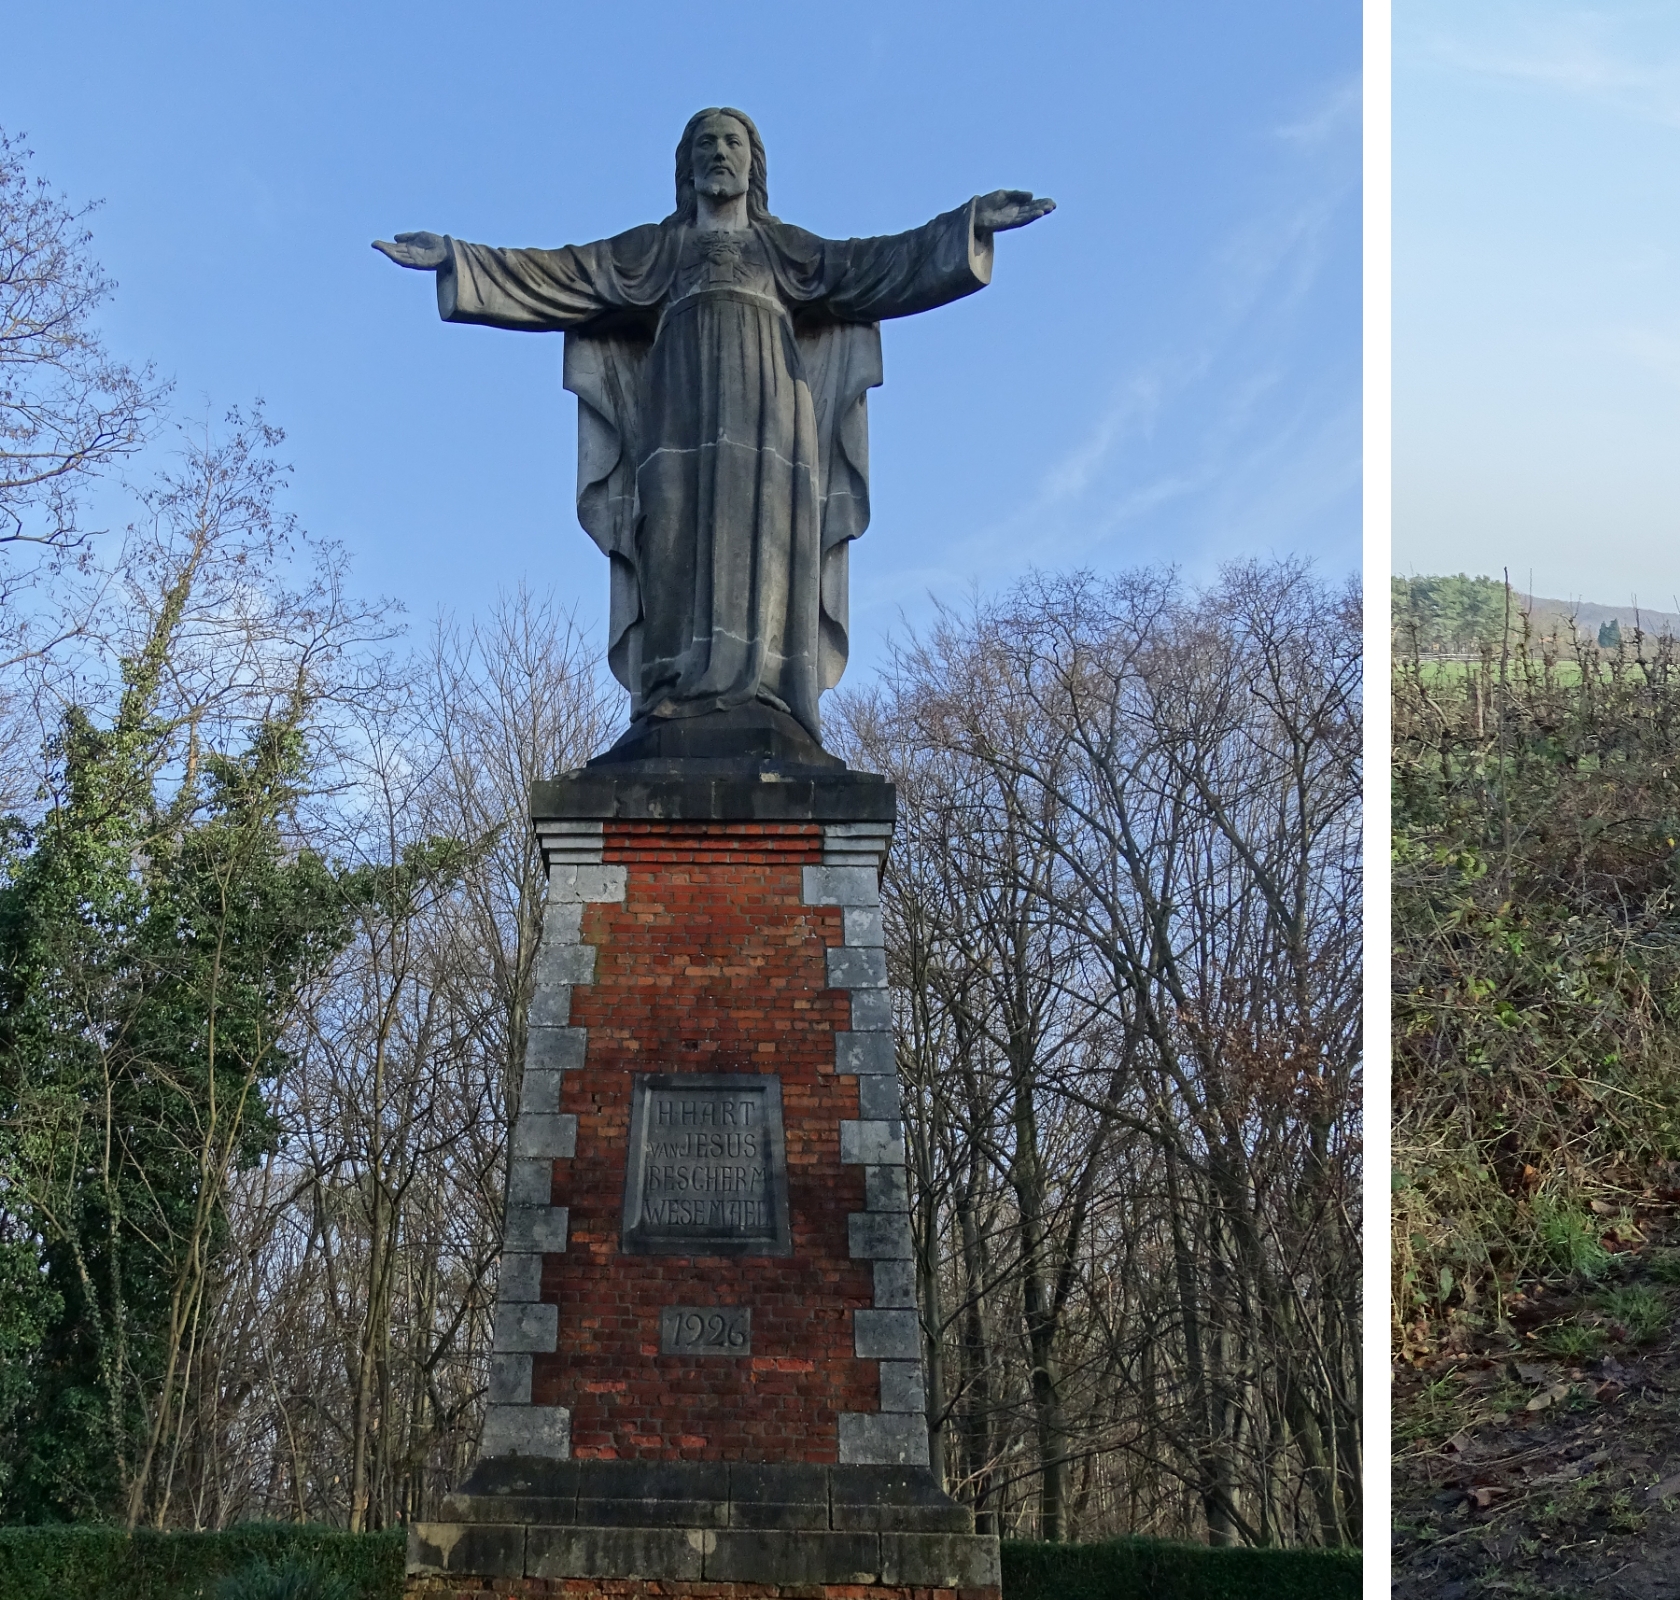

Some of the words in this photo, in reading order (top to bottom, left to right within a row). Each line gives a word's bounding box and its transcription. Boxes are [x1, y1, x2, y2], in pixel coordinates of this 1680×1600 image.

[648, 1141, 678, 1158] VAN
[679, 1132, 757, 1158] JESUS
[648, 1165, 767, 1192] BESCHERM
[670, 1313, 745, 1347] 1926
